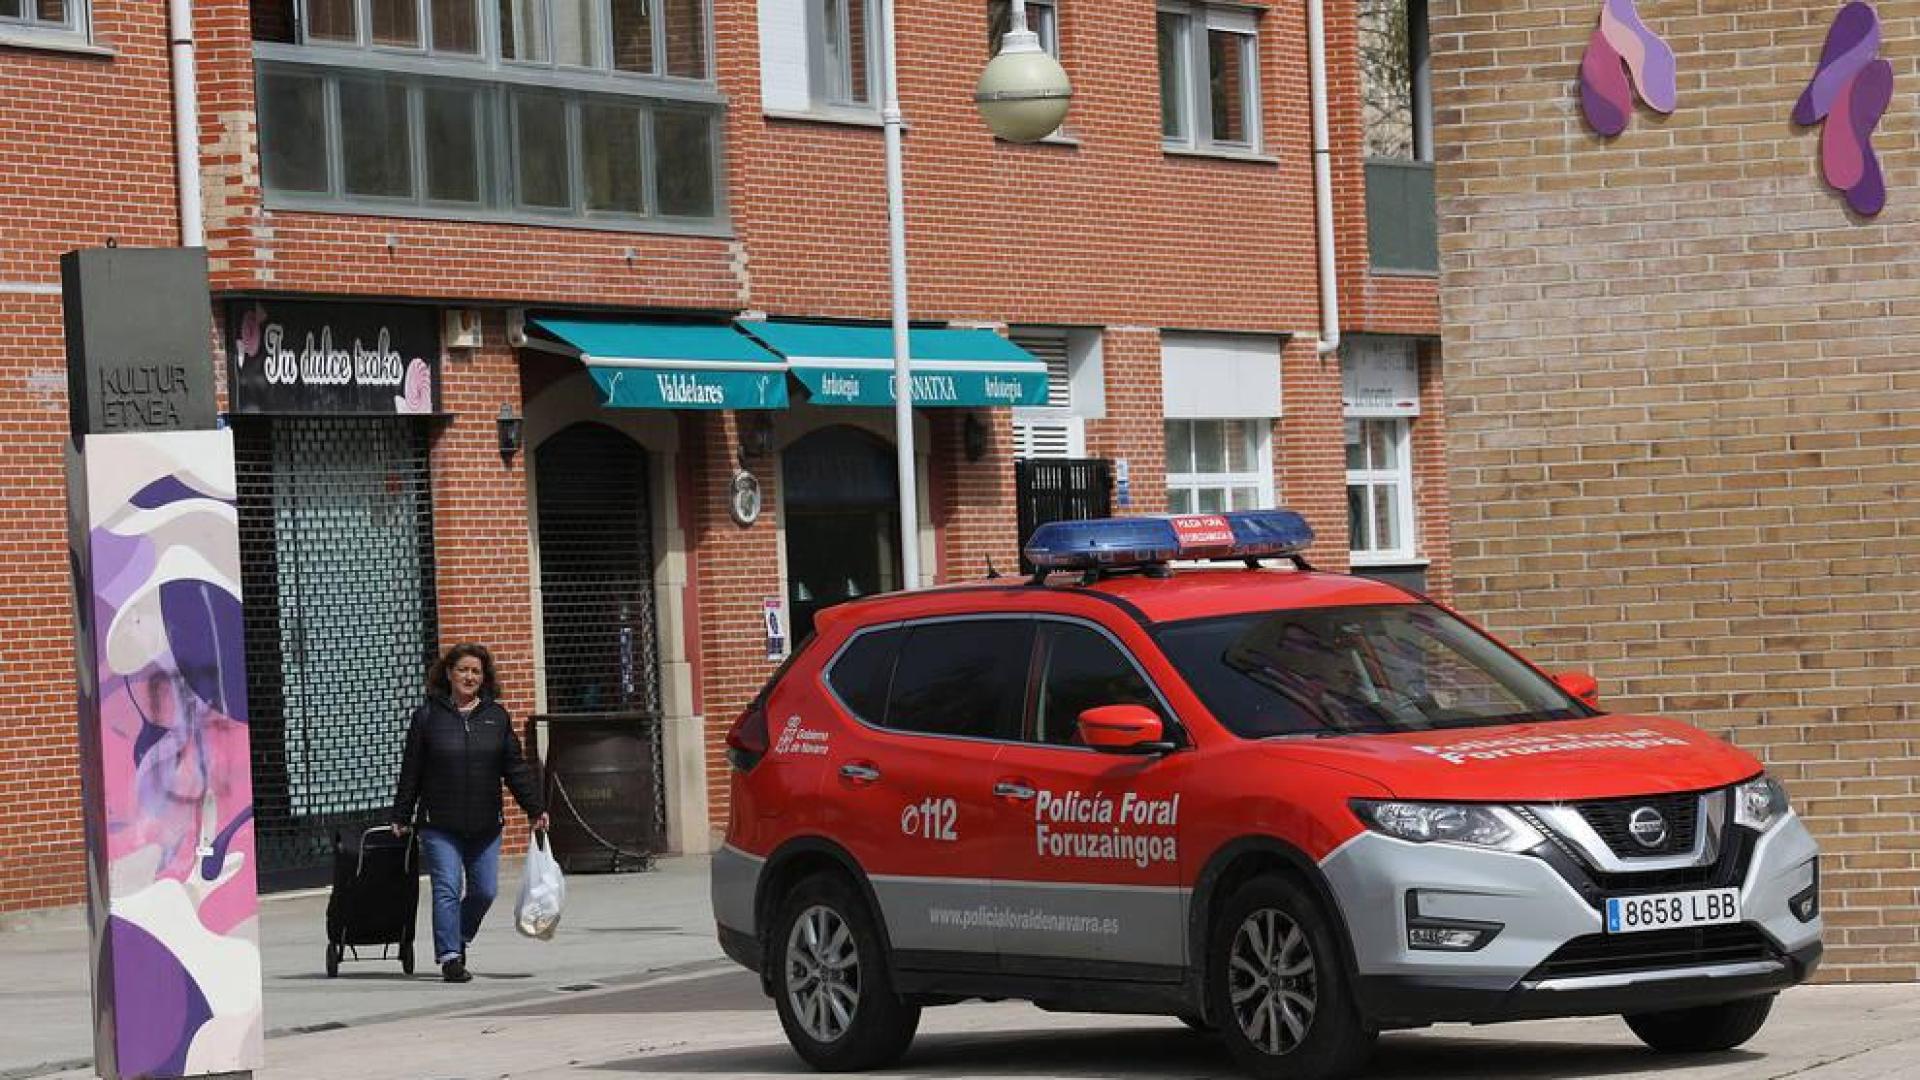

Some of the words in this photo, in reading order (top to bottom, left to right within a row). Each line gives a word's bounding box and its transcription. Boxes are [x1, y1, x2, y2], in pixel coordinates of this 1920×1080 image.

[264, 323, 298, 384] Tu
[300, 325, 351, 384] dulce
[100, 363, 188, 394] KULTUR
[656, 373, 724, 404] Valdelares
[888, 375, 957, 400] GRNATXA
[102, 400, 180, 427] ETXEA
[1438, 736, 1690, 764] Foruzaingoa
[920, 797, 958, 841] 112
[1035, 790, 1112, 823] Policía
[1119, 792, 1180, 825] Foral
[1036, 823, 1177, 868] Foruzaingoa
[1626, 898, 1682, 926] 8658
[1691, 893, 1736, 921] LBB
